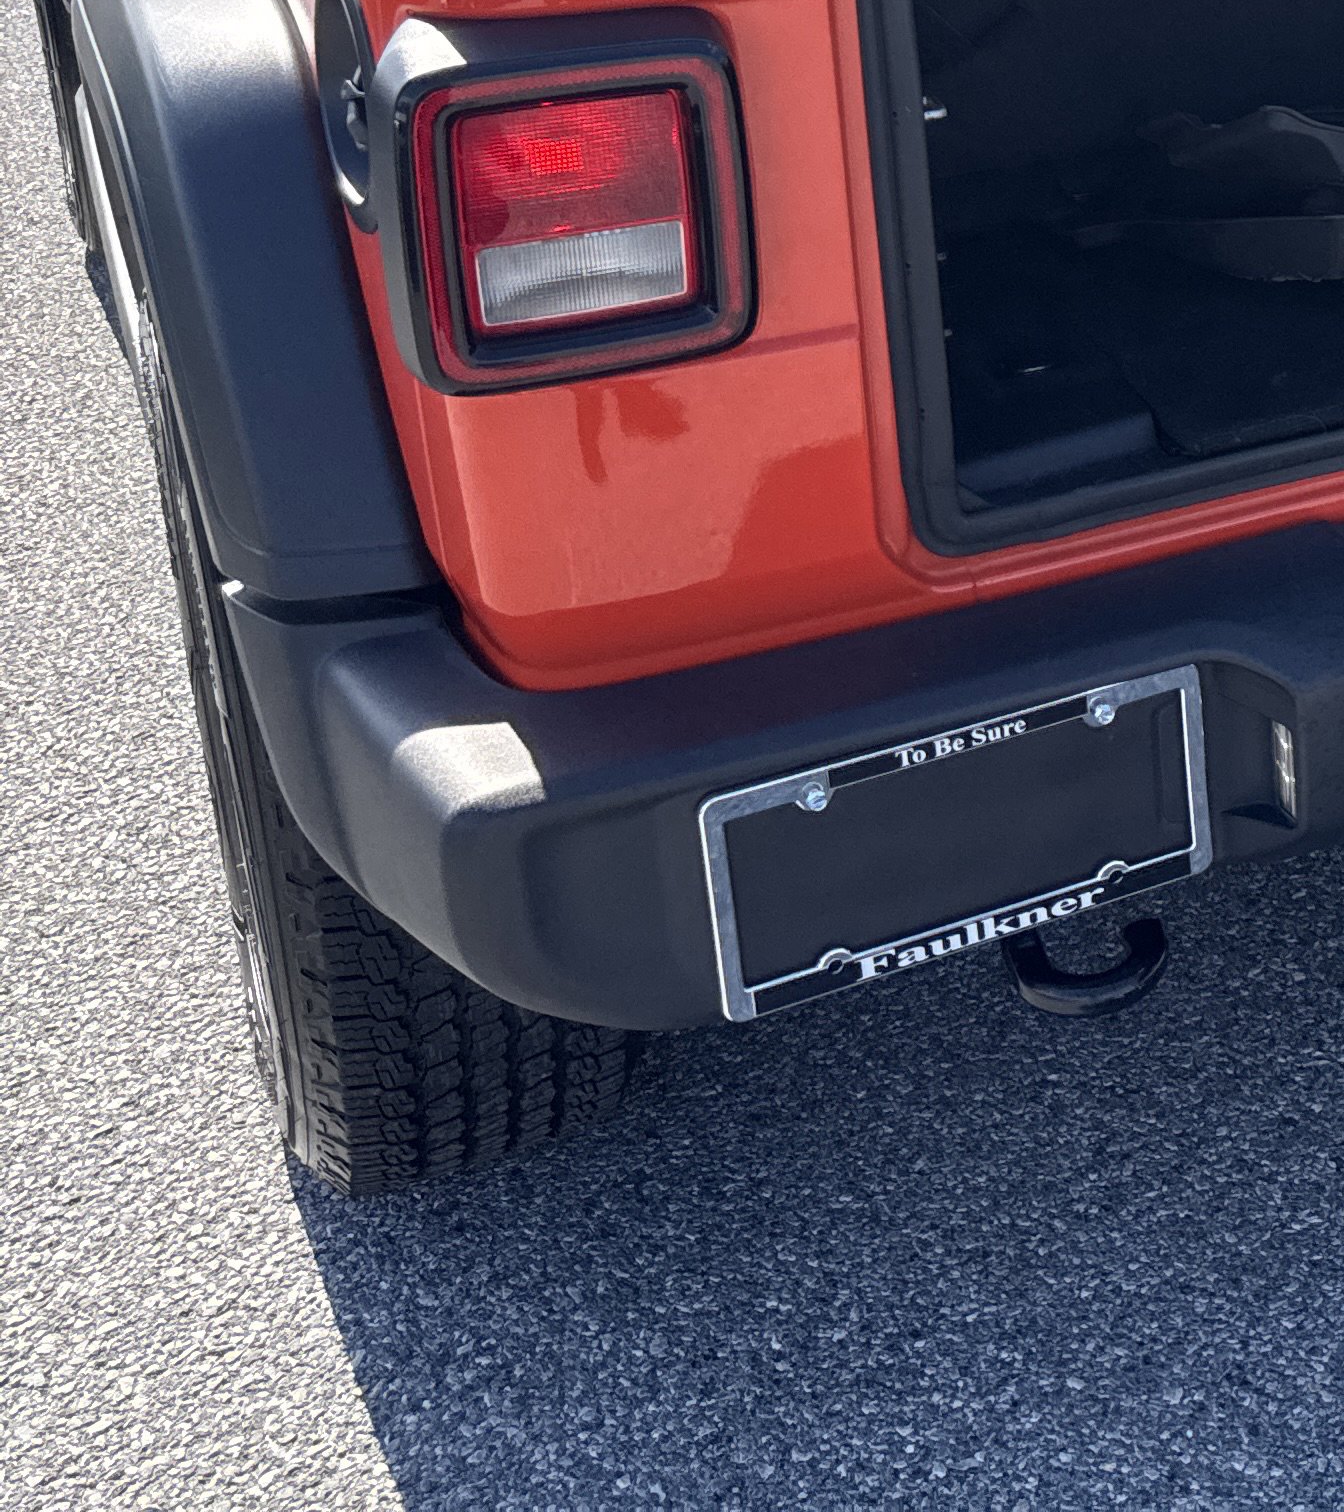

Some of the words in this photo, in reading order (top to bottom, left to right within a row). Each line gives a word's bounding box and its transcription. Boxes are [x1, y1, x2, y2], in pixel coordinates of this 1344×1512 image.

[894, 746, 927, 769] To
[934, 735, 965, 759] Be
[970, 715, 1028, 748] Sure
[855, 885, 1106, 982] Faulkner
